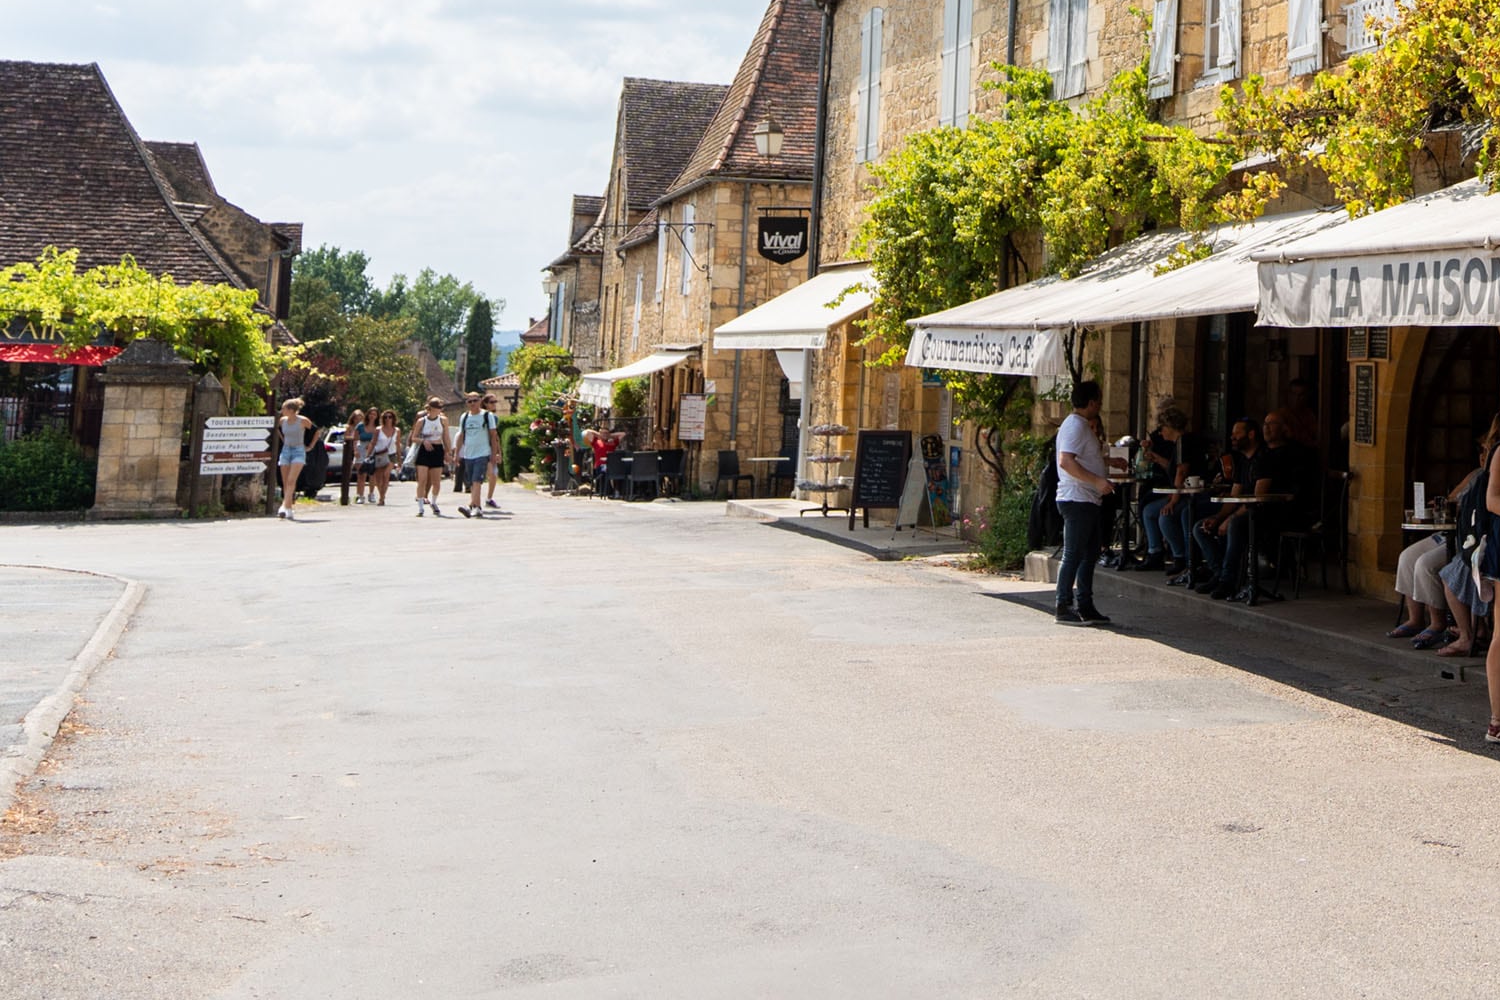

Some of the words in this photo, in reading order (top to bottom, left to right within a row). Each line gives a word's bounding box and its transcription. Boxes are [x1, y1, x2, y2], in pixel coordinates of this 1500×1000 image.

[762, 231, 804, 249] Vival
[1329, 266, 1363, 318] LA
[921, 333, 1005, 367] Gourmandises
